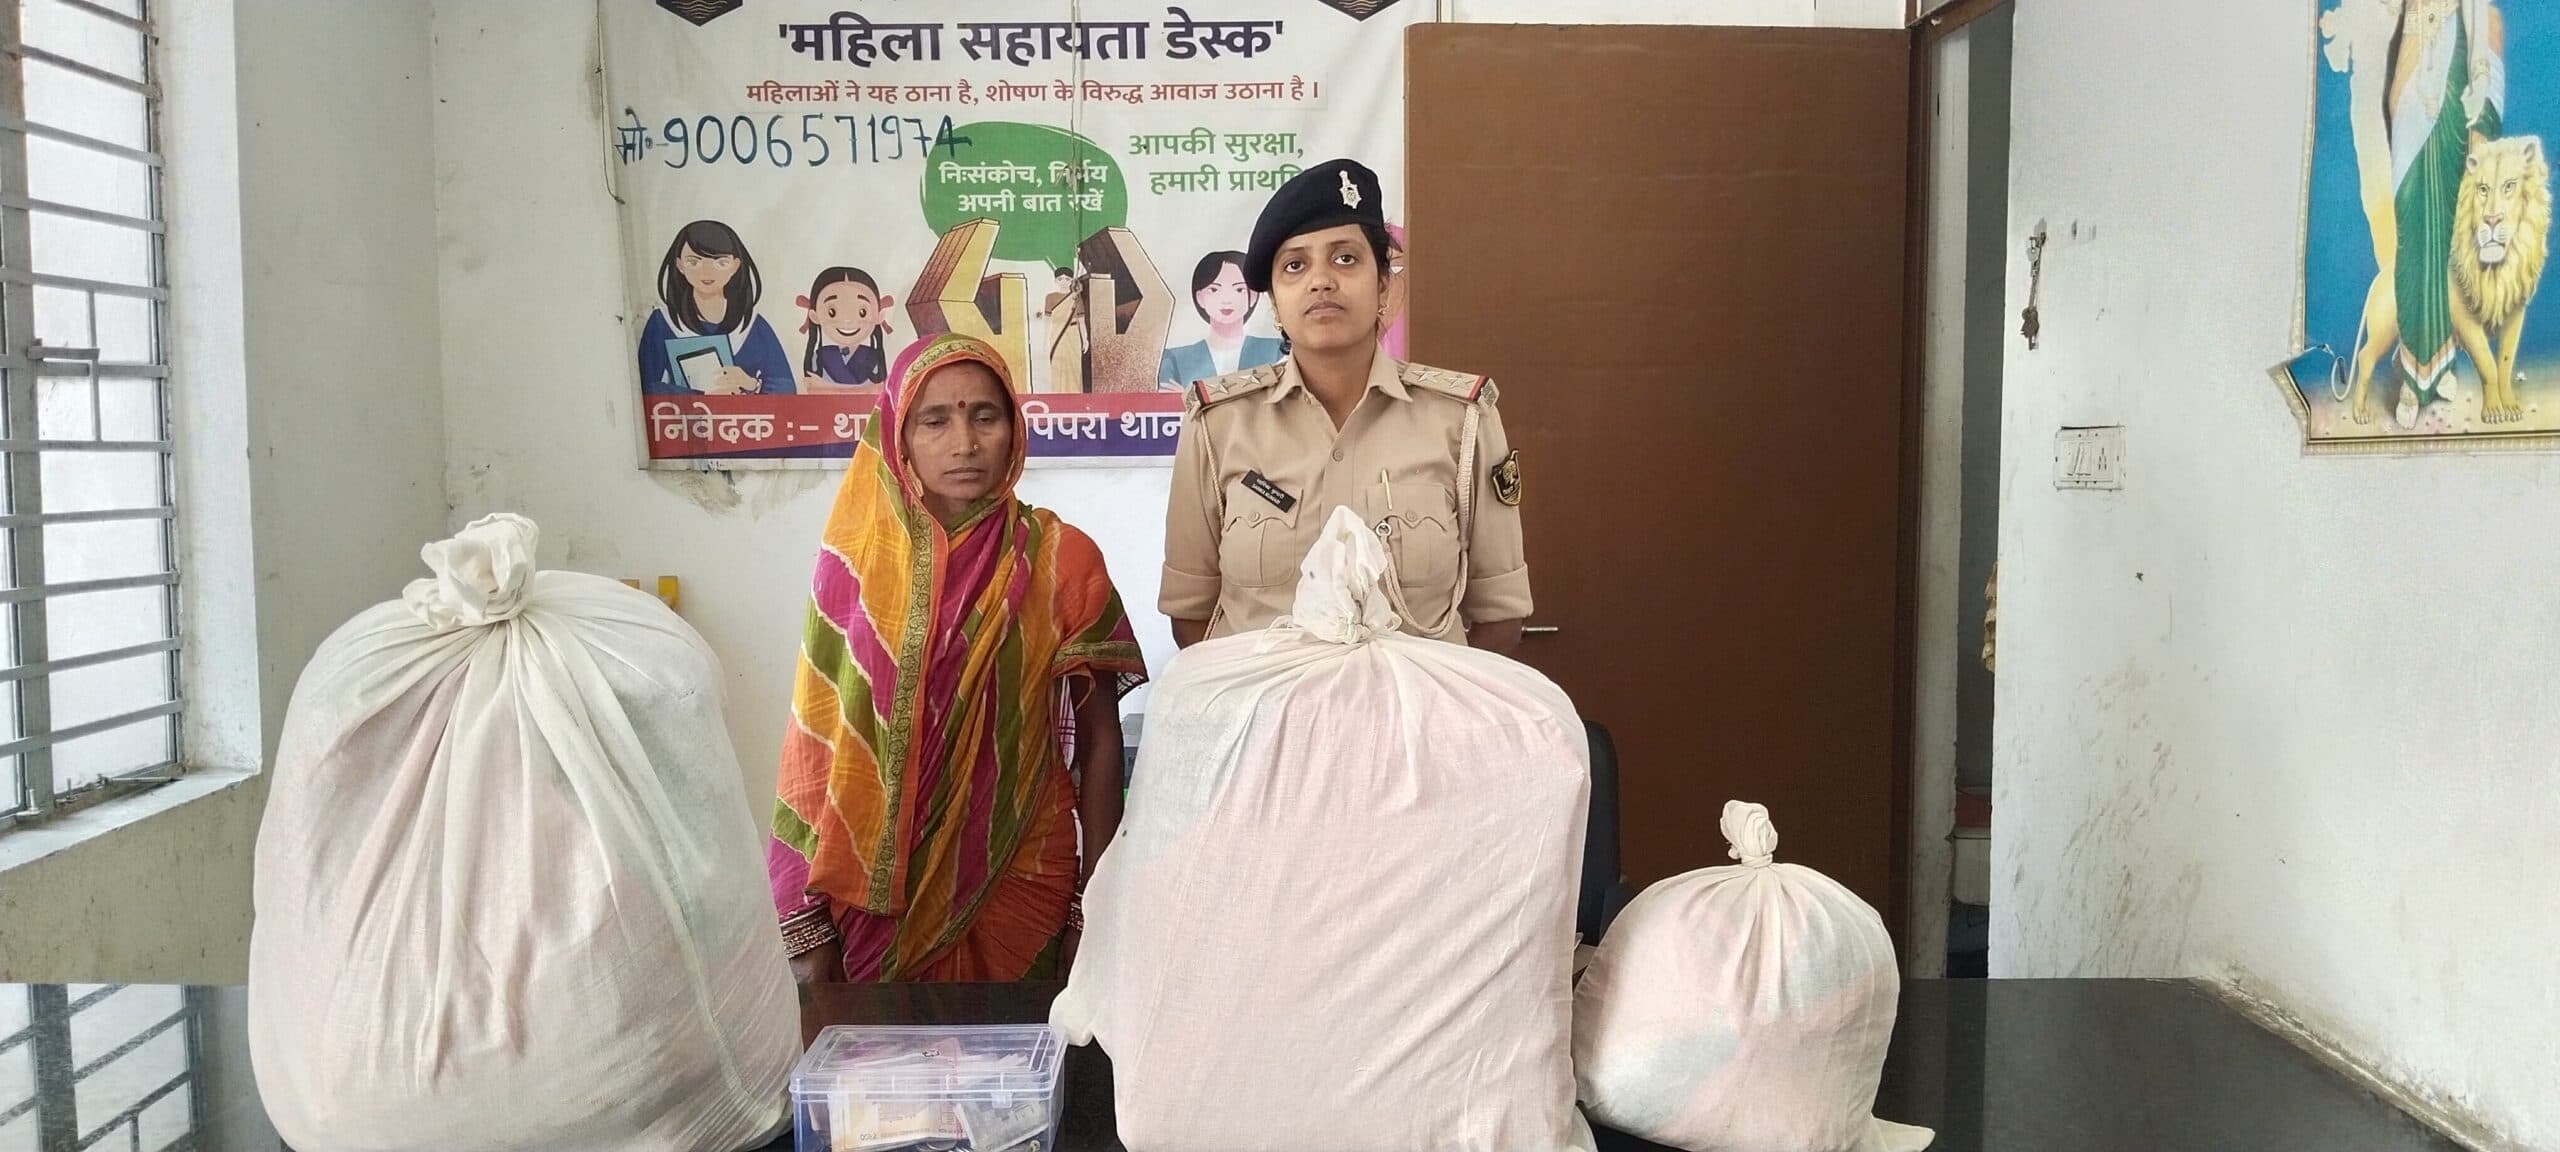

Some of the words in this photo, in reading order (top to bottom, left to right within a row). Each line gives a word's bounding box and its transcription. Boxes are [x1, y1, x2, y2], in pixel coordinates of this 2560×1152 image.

[957, 20, 1150, 67] सहायता
[746, 80, 840, 104] महिलाओं
[845, 80, 861, 102] ने
[867, 84, 898, 104] यह
[904, 85, 952, 102] ठाना
[957, 78, 979, 106] है,
[986, 80, 1048, 102] शोषण
[1053, 79, 1074, 101] के
[1080, 80, 1144, 104] विरुद्ध
[1150, 84, 1218, 101] आवाज
[1224, 82, 1284, 100] उठाना
[1290, 74, 1304, 101] है
[1129, 127, 1216, 156] आपकी
[1224, 132, 1304, 162] सुरक्षा,
[1149, 164, 1221, 196] हमारी
[958, 188, 1016, 212] अपनी
[1021, 194, 1063, 212] बात
[1067, 187, 1105, 212] रखें
[650, 401, 775, 444] निवेदक
